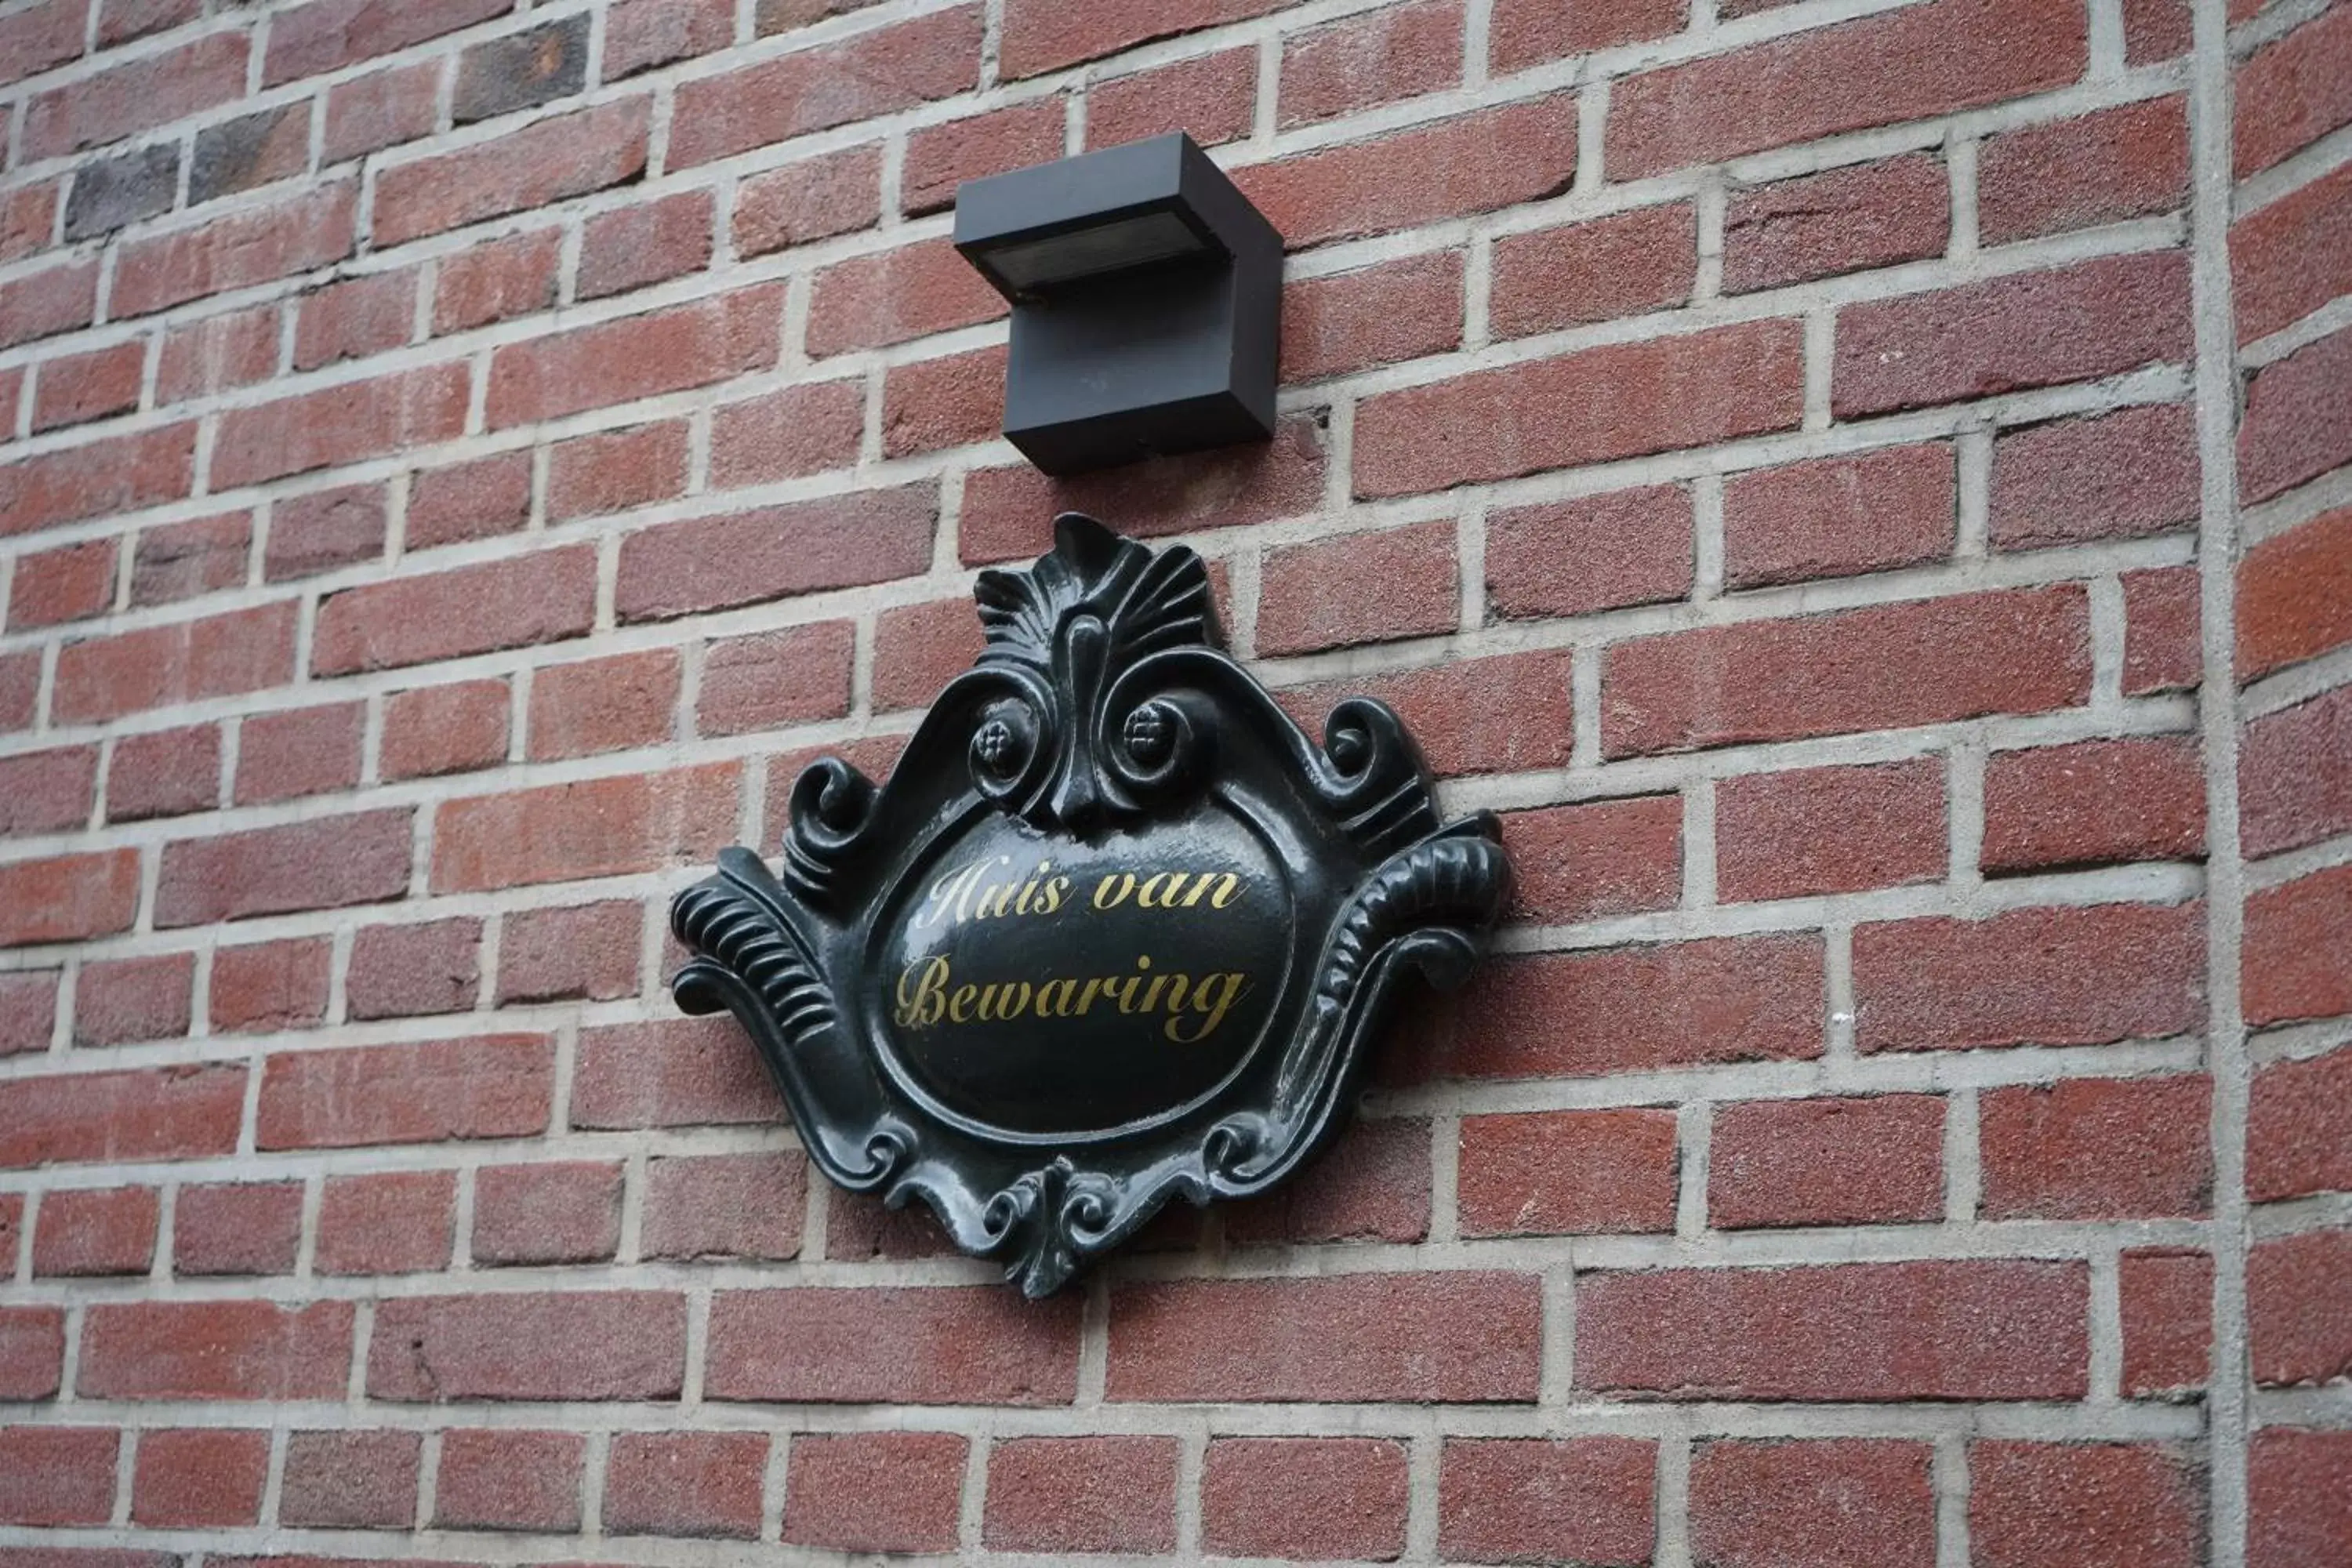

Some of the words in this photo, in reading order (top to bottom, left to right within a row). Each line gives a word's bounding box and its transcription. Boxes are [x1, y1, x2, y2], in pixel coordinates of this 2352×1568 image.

[915, 855, 1077, 929] Huis
[1094, 871, 1251, 910] van
[894, 953, 1254, 1044] Bewaring
